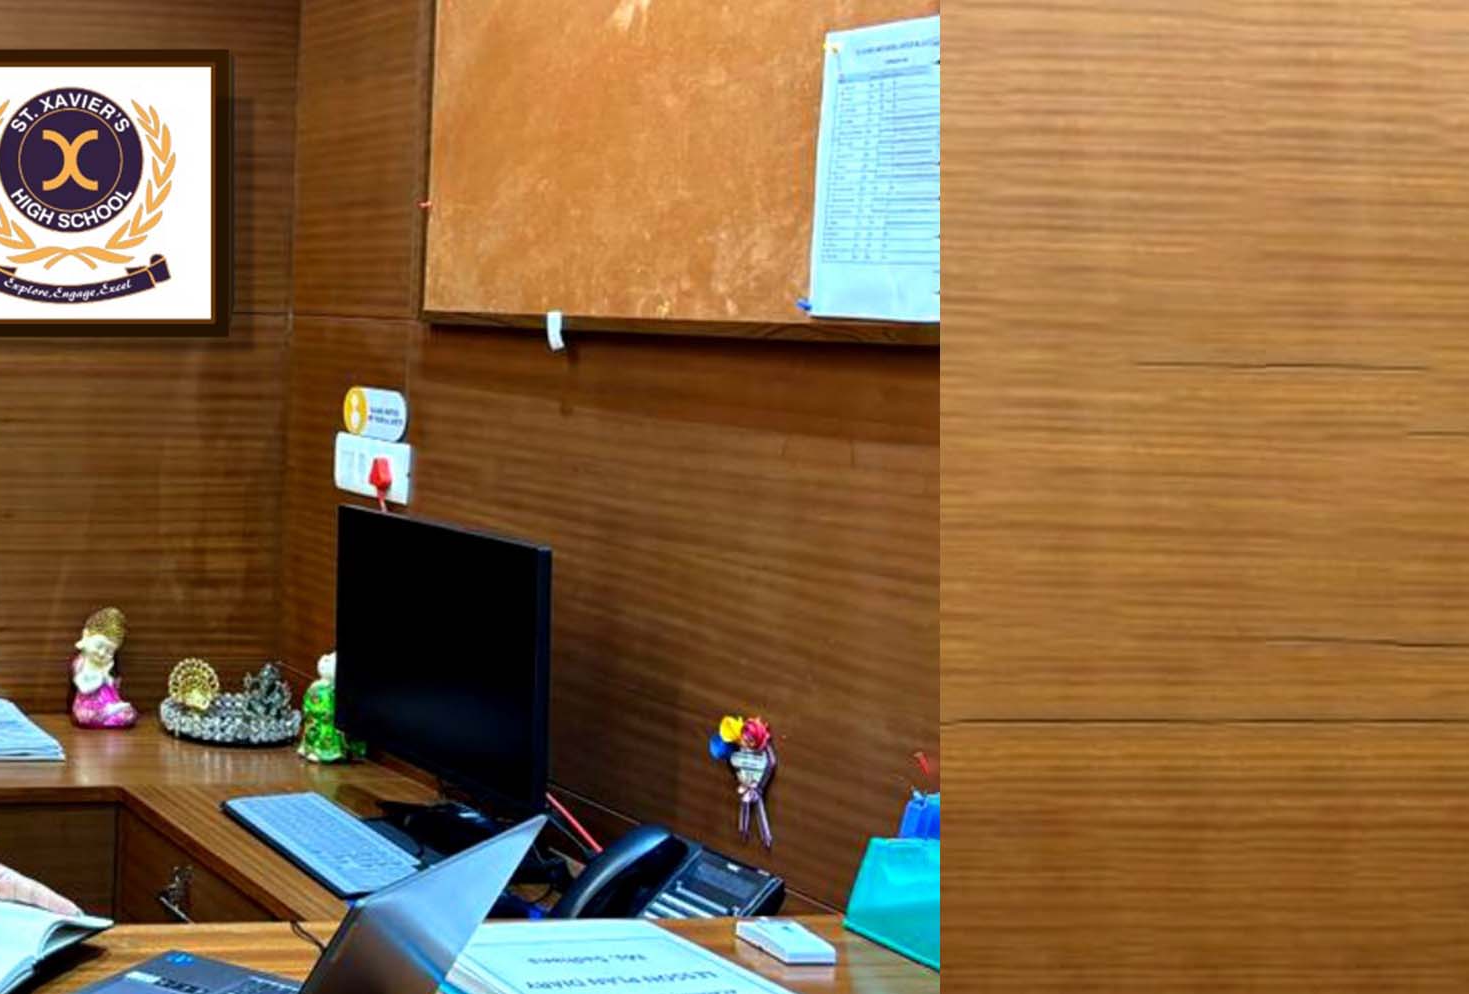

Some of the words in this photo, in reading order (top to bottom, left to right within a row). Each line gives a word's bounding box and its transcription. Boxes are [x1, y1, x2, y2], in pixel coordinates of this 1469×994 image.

[11, 107, 39, 133] ST.
[39, 93, 131, 132] XAVIER'S
[10, 188, 55, 225] HIGH
[57, 190, 133, 229] SCHOOL
